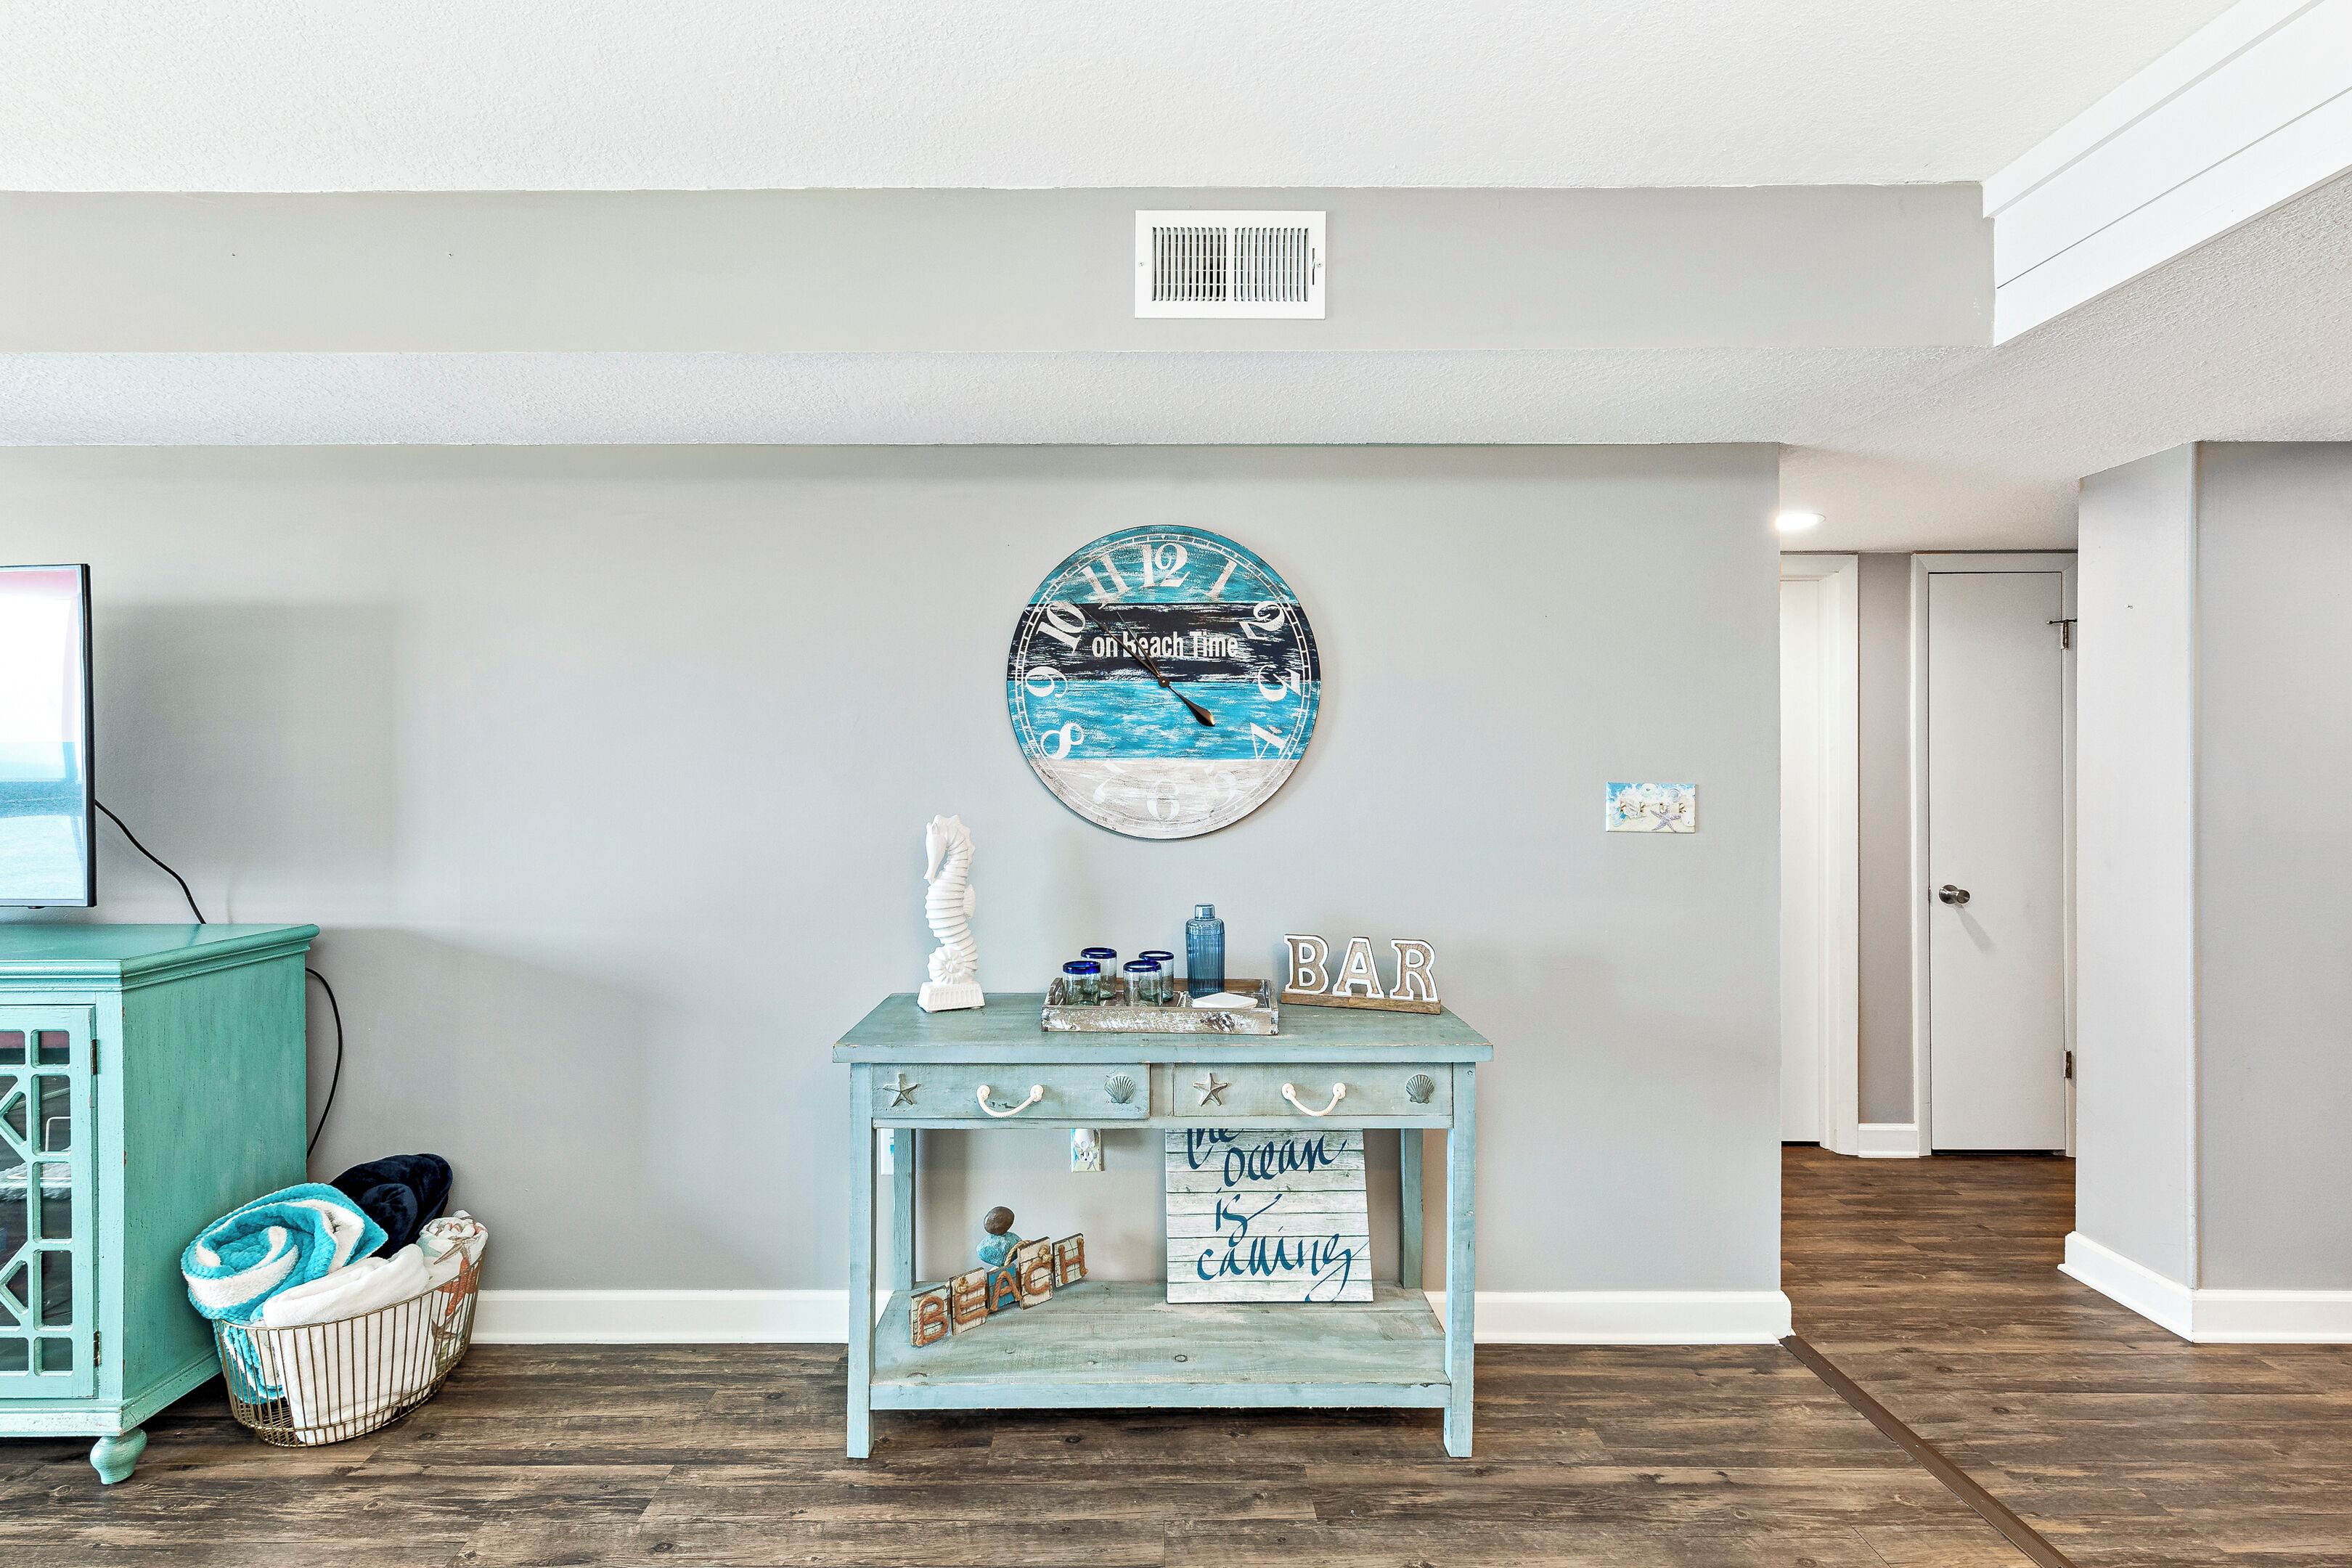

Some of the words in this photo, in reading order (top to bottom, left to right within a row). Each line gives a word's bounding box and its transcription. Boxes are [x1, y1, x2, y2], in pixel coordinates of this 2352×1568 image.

[1079, 553, 1132, 610] 11
[1142, 543, 1191, 588] 12
[1205, 557, 1238, 600] 1
[1037, 600, 1086, 653] 10
[1241, 600, 1285, 640] 2
[1092, 636, 1117, 658] on
[1123, 631, 1184, 658] Beach
[1190, 631, 1238, 658] Time
[1025, 666, 1069, 698] 9
[1257, 664, 1302, 702] 3
[1040, 722, 1085, 760] 8
[1250, 722, 1288, 761] 4
[1283, 933, 1439, 1001] BAR
[1223, 1134, 1348, 1187] ocean
[1215, 1187, 1283, 1247] is
[1197, 1226, 1371, 1302] calling
[915, 1238, 1089, 1347] BEACH
